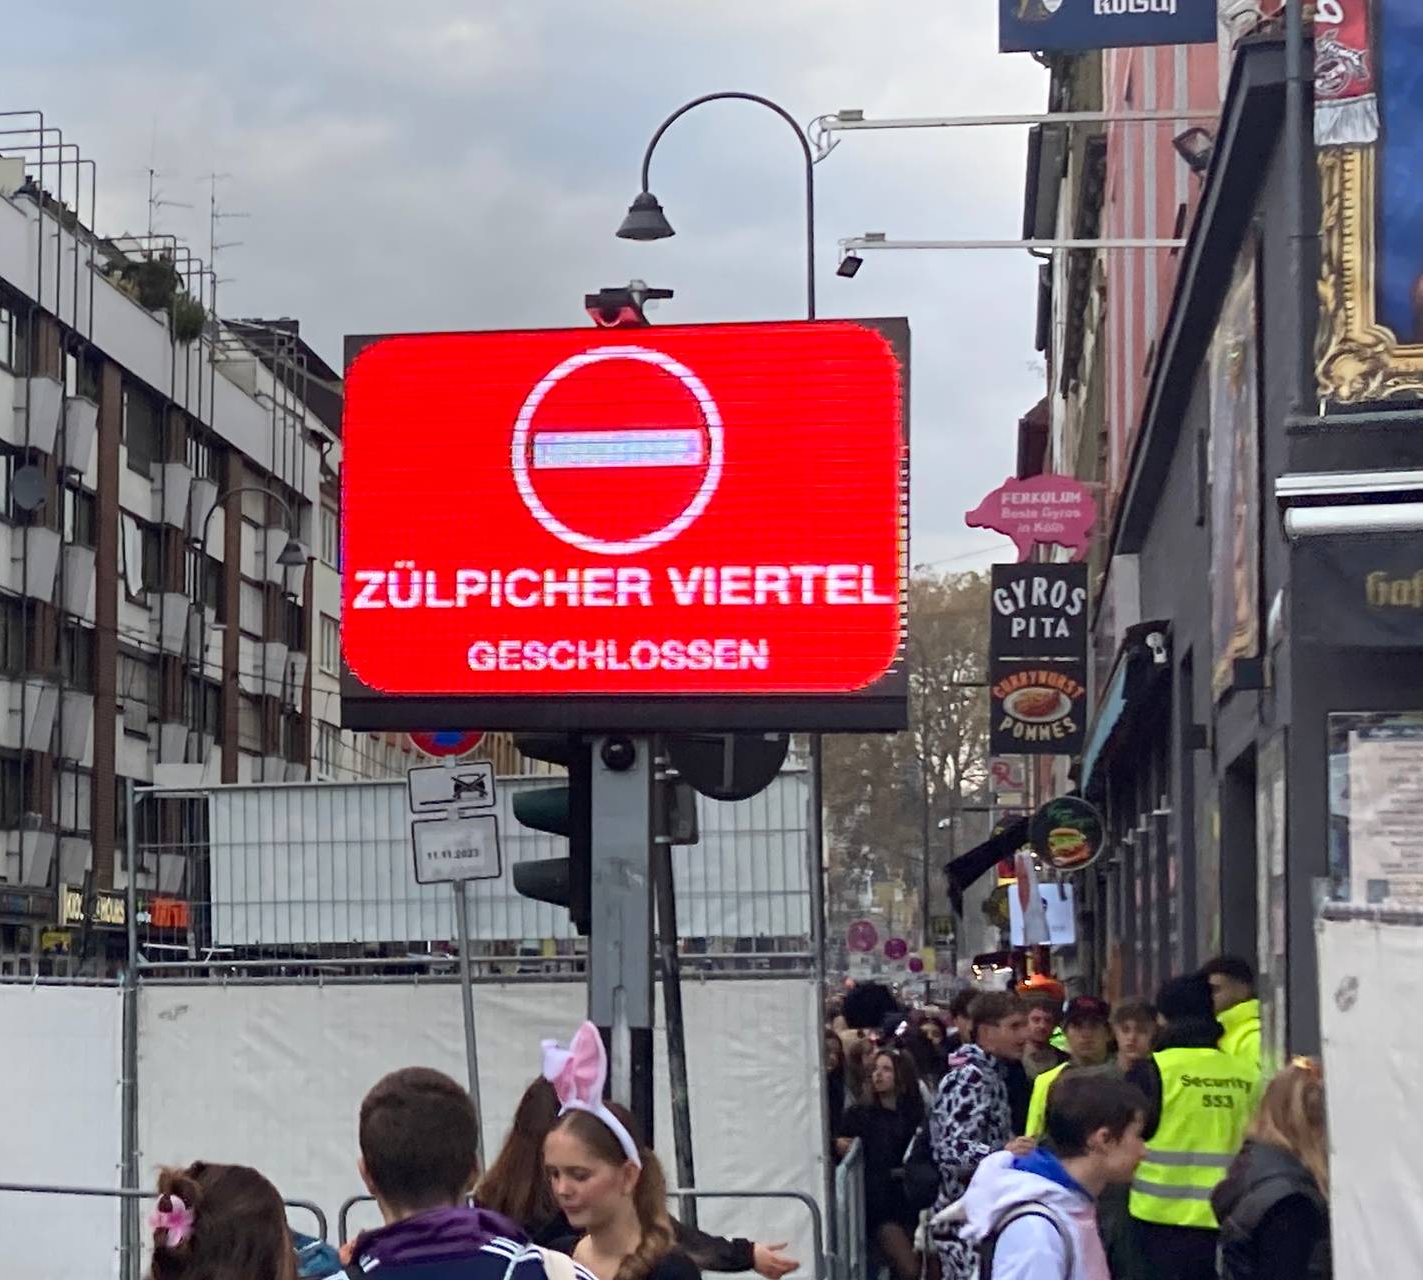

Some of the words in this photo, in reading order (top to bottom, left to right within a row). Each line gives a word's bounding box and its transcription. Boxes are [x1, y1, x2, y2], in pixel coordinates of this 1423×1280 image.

[1001, 507, 1038, 519] Beste
[1042, 507, 1081, 520] Gyros
[1018, 522, 1030, 533] in
[1034, 521, 1065, 534] Köln
[353, 560, 653, 610] ZÜLPICHER
[668, 564, 895, 606] VIERTEL
[993, 576, 1087, 617] GYROS
[1010, 617, 1070, 639] PITA
[466, 639, 770, 673] GESCHLOSSEN
[992, 670, 1086, 699] CURRYWURST
[998, 715, 1078, 742] POMMES
[1180, 1074, 1253, 1095] Security
